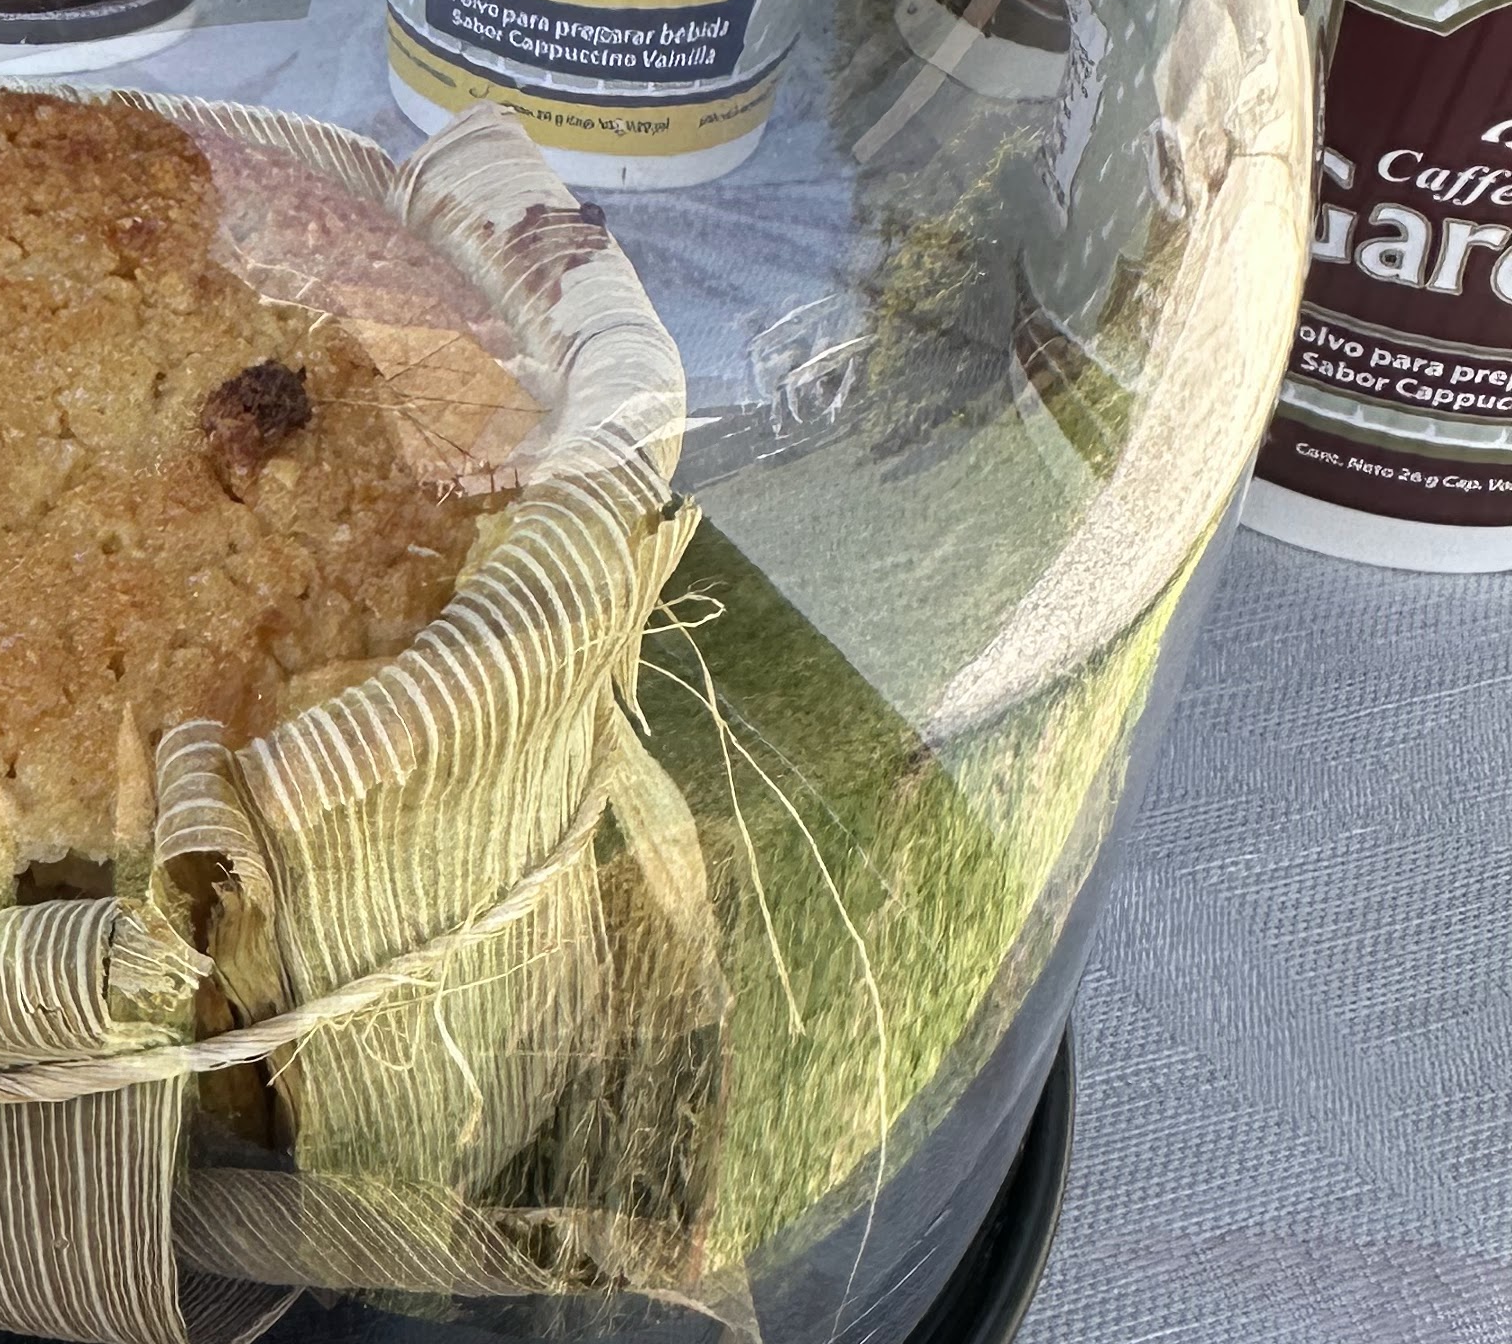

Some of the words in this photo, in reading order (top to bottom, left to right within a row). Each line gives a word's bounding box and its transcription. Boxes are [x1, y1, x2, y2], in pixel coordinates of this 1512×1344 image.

[451, 8, 503, 42] Sabor
[509, 29, 637, 67] Cappuccino
[642, 44, 716, 69] Vainilla
[502, 8, 549, 32] para
[554, 20, 655, 46] preparar
[1300, 351, 1390, 391] Sabor
[1369, 347, 1445, 377] para
[1442, 475, 1483, 492] Cap.
